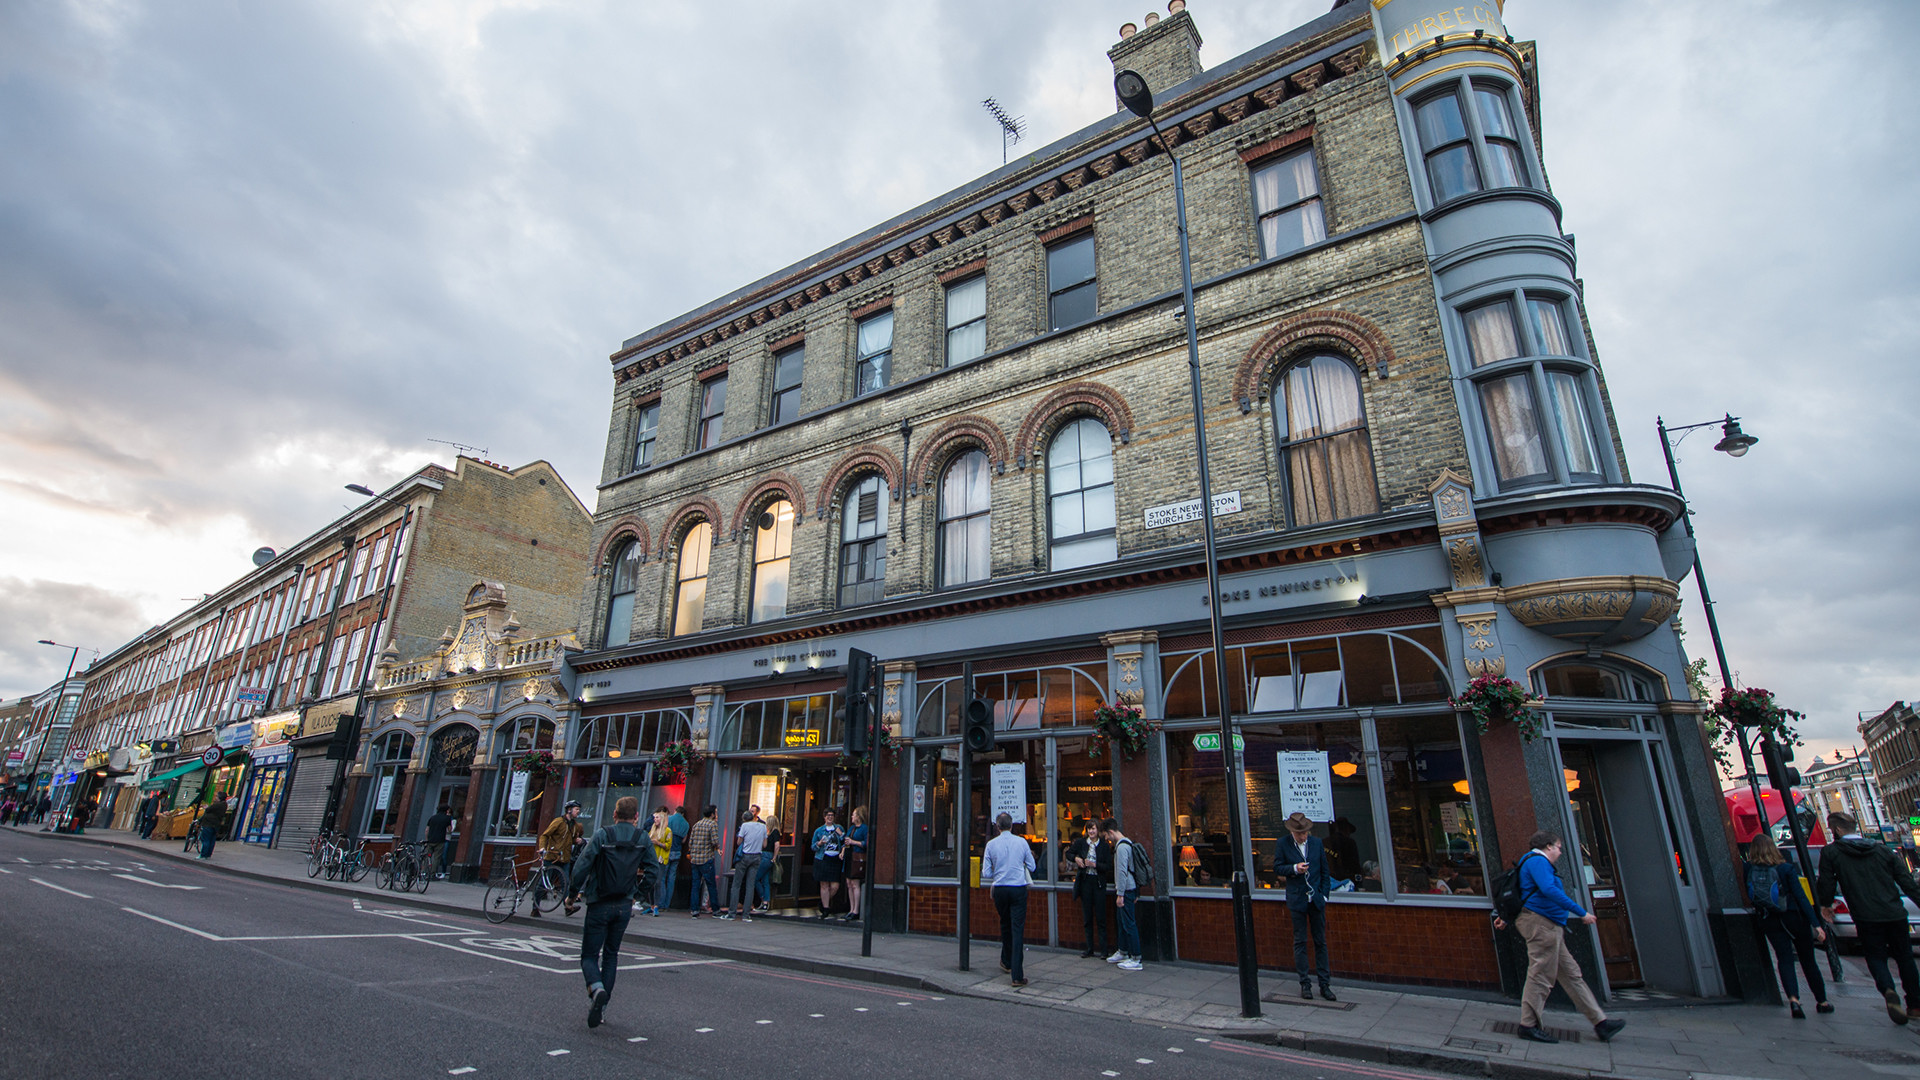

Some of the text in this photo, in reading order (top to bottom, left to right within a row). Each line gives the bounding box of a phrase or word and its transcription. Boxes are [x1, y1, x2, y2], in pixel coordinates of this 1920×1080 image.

[1389, 6, 1470, 52] THREE
[1147, 514, 1184, 527] CHURCH
[1186, 507, 1220, 520] STRET
[1149, 497, 1235, 519] STOKE NEWIGTON
[1201, 573, 1359, 606] SOKE NEWINGTON
[205, 751, 218, 759] 30
[1776, 830, 1792, 839] 73
